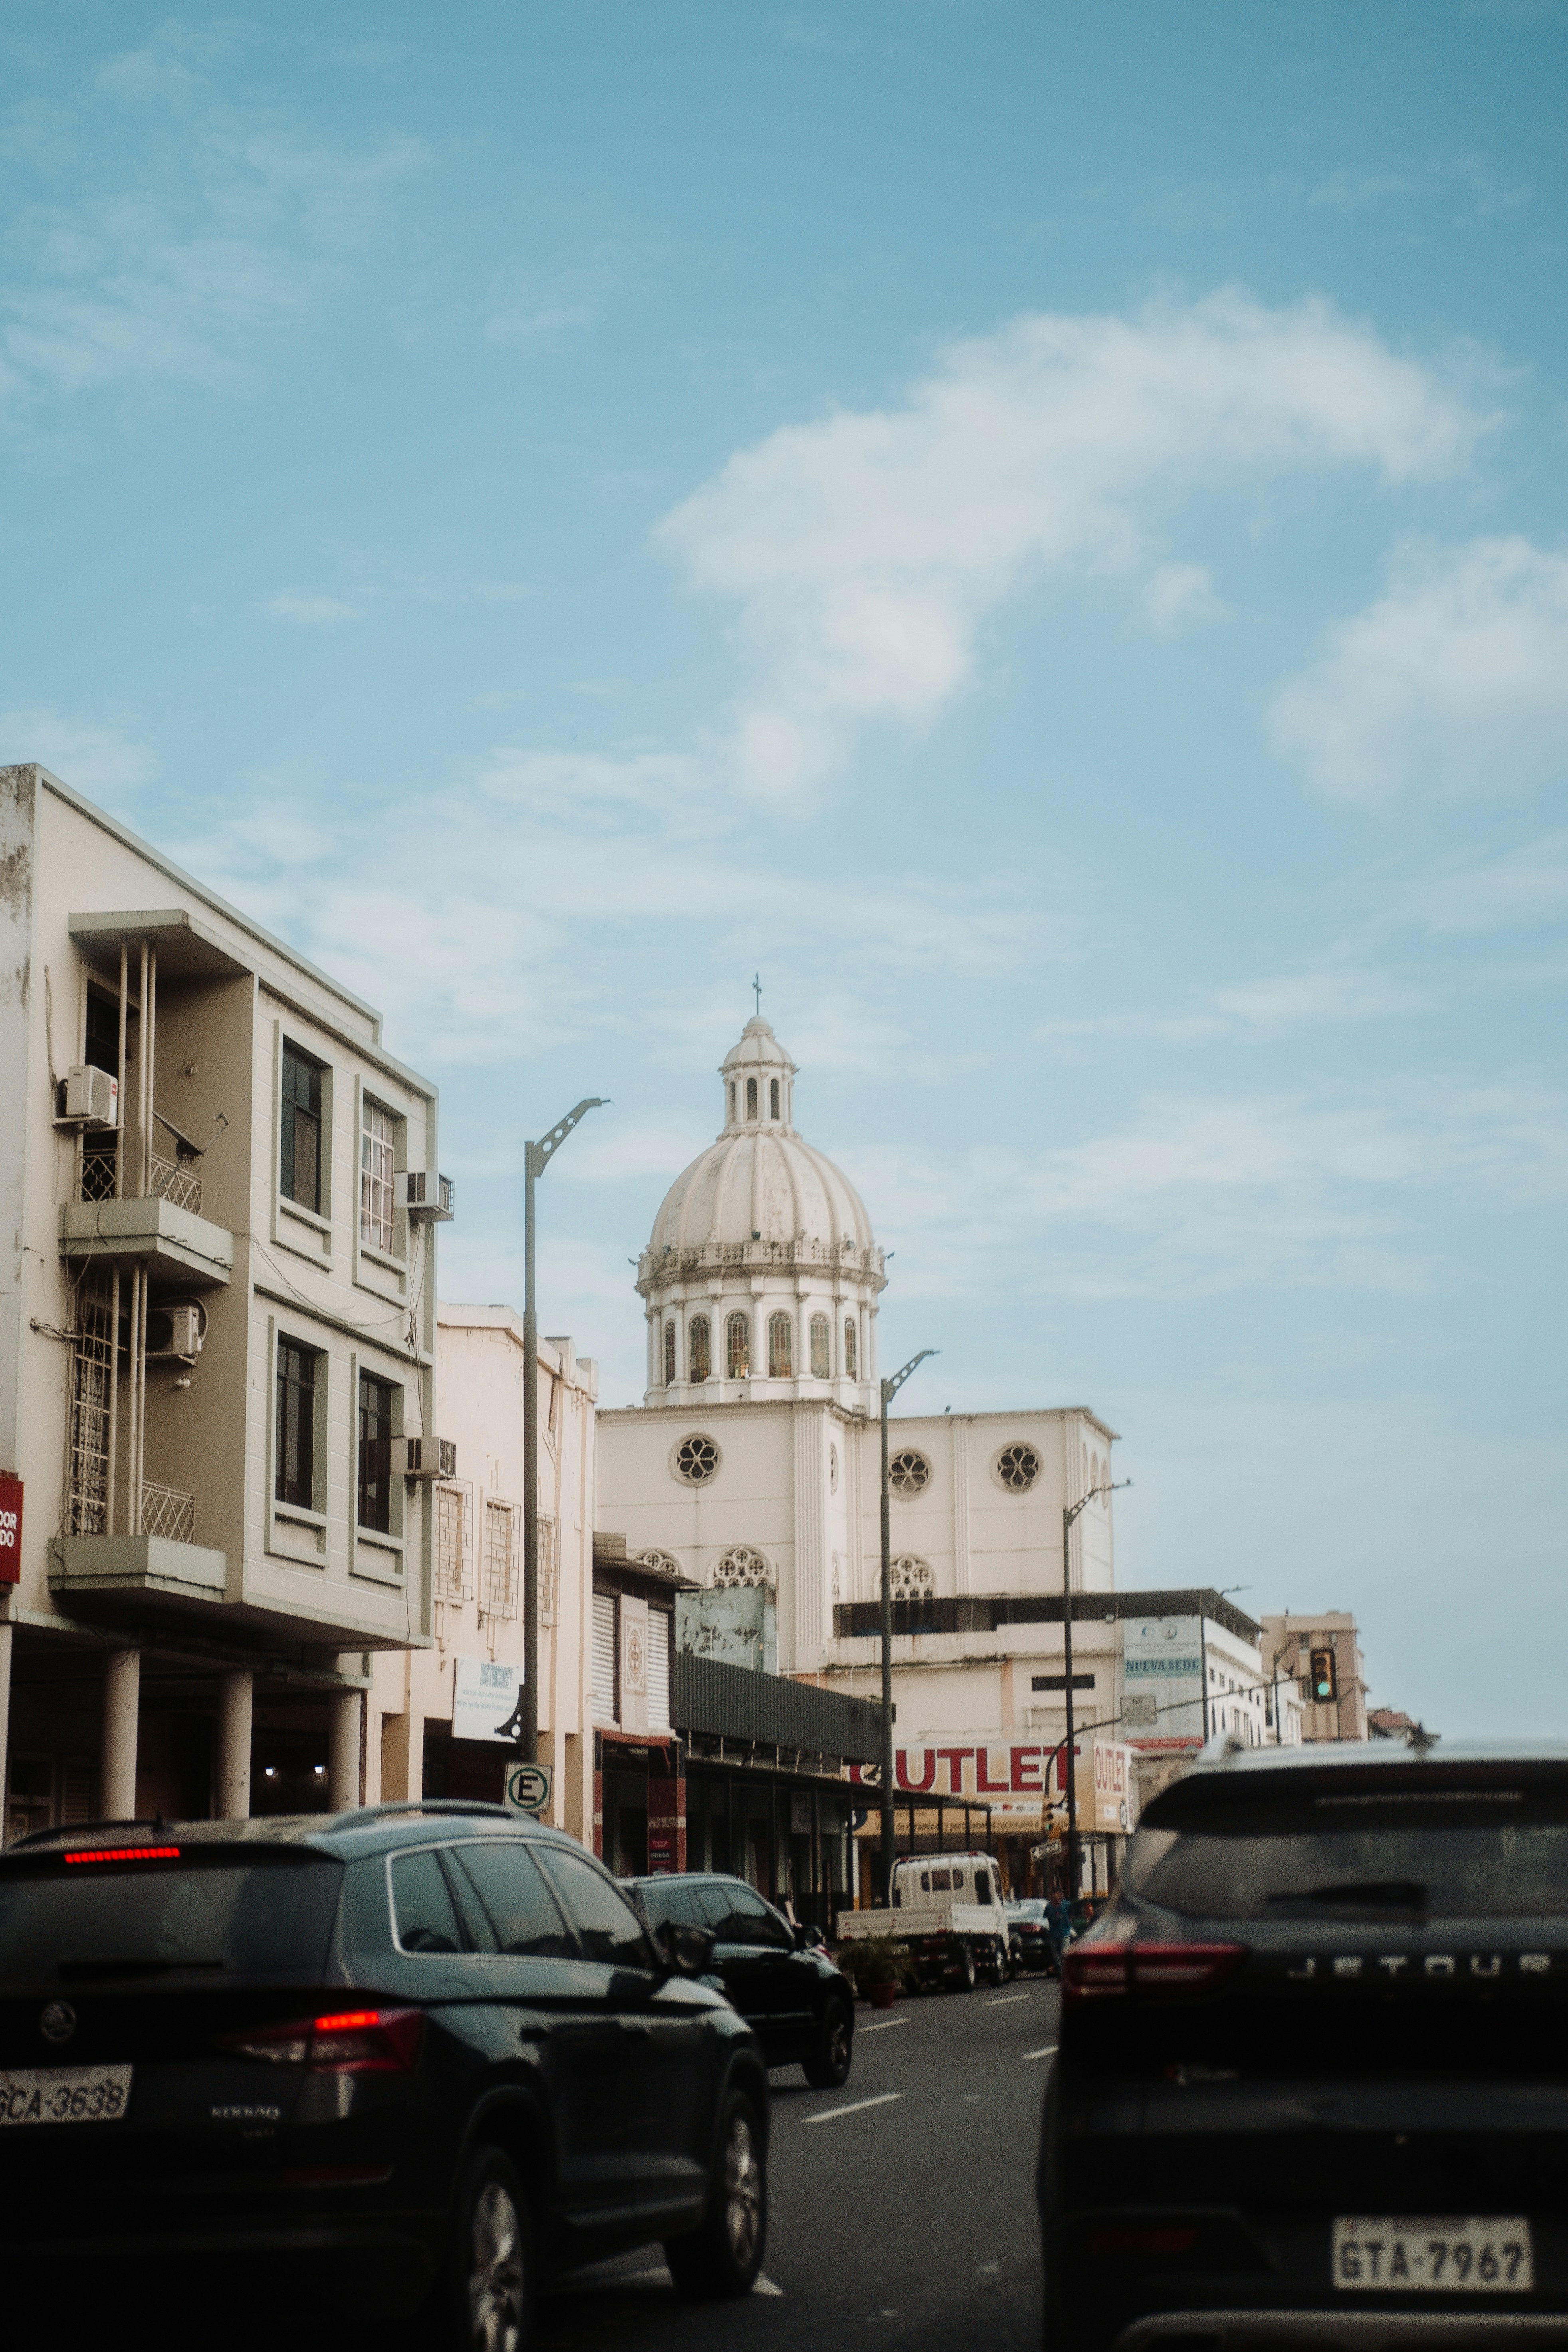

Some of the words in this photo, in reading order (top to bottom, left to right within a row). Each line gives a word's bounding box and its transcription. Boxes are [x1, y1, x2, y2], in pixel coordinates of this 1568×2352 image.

[1126, 1659, 1165, 1673] NUEVA
[1168, 1658, 1199, 1671] SEDE
[1095, 1745, 1125, 1792] OUTLET
[518, 1775, 538, 1801] E
[1287, 1955, 1551, 1978] JETOUR
[211, 2104, 281, 2122] KODIAQ
[1340, 2240, 1522, 2281] GTA-7967
